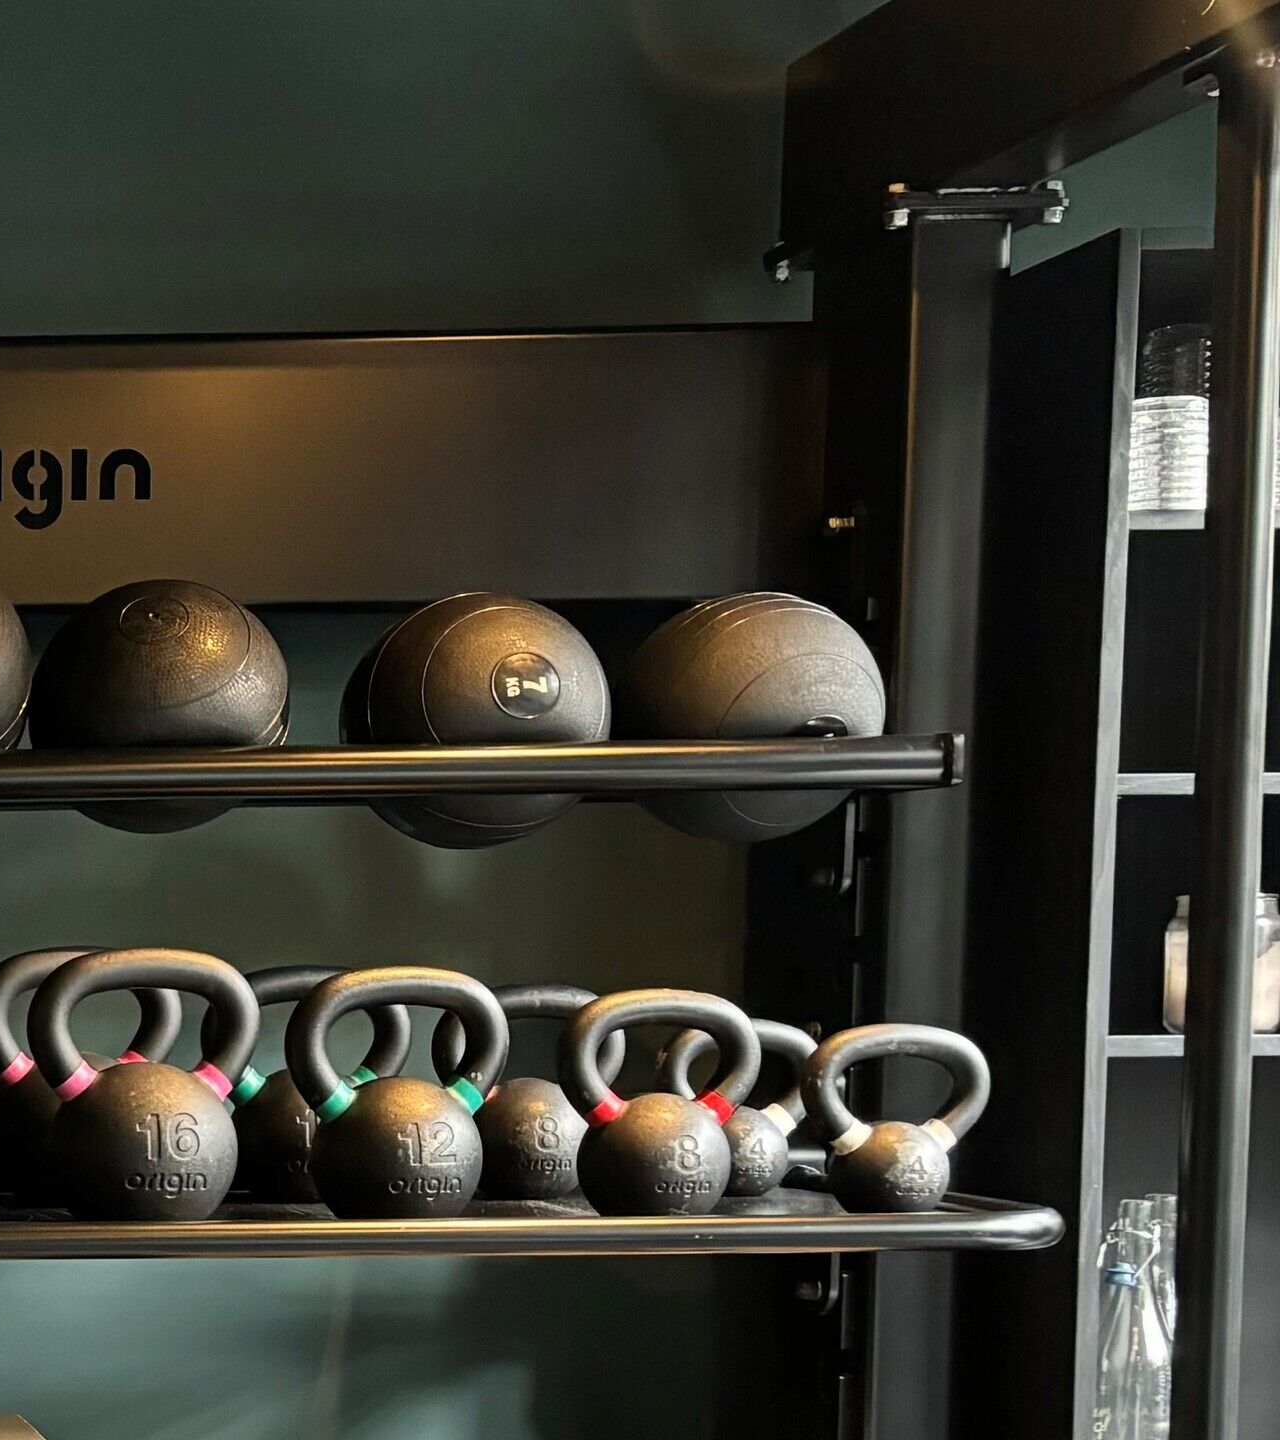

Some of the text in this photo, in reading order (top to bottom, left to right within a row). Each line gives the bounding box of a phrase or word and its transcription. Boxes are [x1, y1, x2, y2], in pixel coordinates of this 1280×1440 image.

[505, 676, 521, 697] KG
[522, 676, 548, 693] 7
[135, 1112, 200, 1162] 16
[397, 1121, 458, 1166] 12
[534, 1115, 561, 1153] 8
[673, 1134, 702, 1175] 8
[747, 1137, 767, 1161] 4
[905, 1155, 929, 1181] 4
[124, 1171, 208, 1199] origin
[388, 1175, 463, 1200] origin
